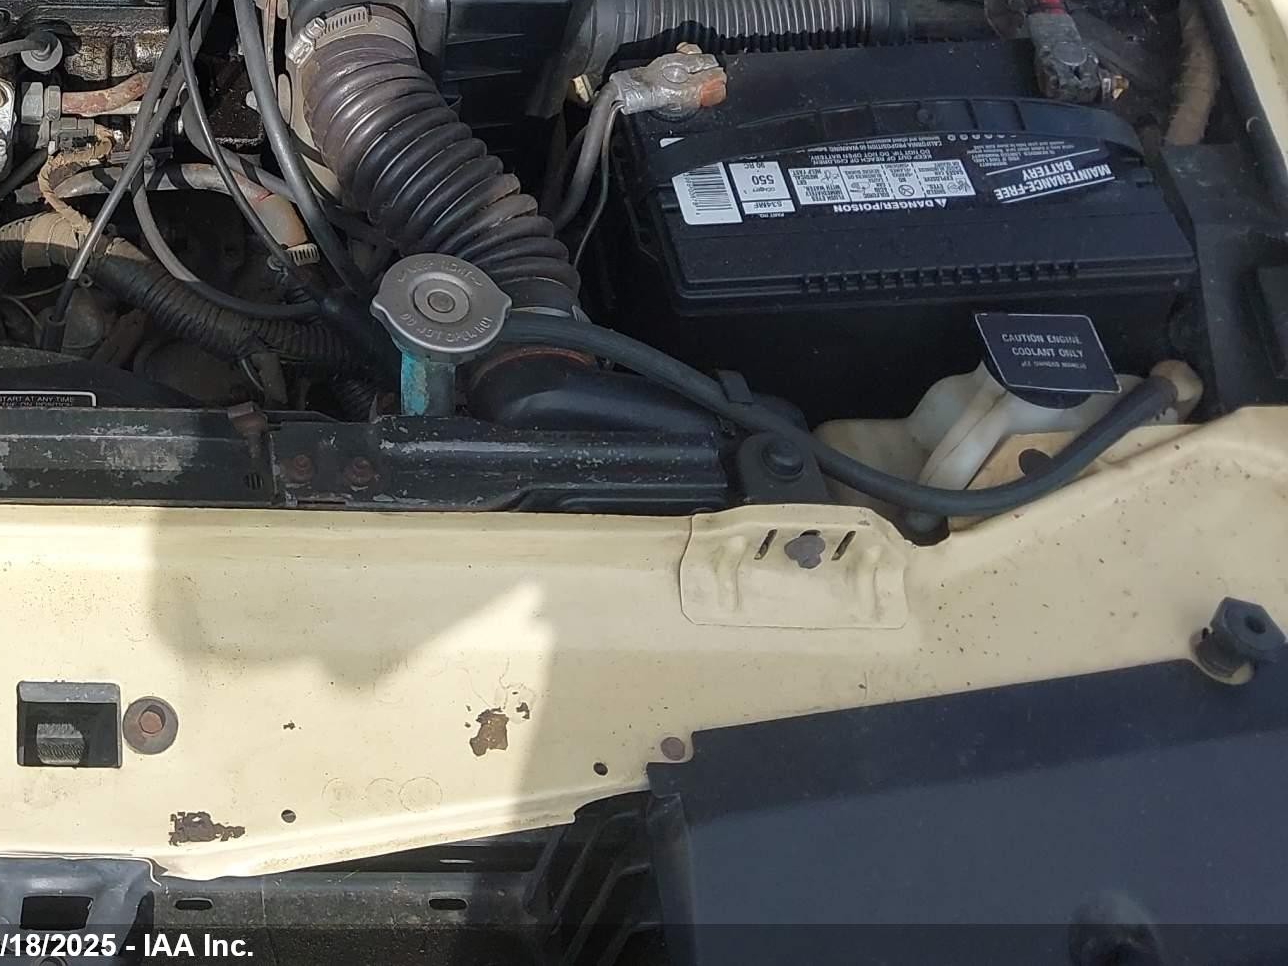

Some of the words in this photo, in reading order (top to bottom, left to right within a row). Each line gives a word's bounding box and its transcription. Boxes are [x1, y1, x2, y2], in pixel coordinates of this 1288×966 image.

[1022, 160, 1075, 181] BATTERY
[752, 175, 774, 185] 550
[993, 164, 1112, 200] MAINTENANCE-FREE
[833, 199, 934, 212] DANGER/POISON
[1001, 333, 1045, 343] CAUTION
[1046, 334, 1083, 345] ENGINE
[1012, 347, 1056, 357] COOLANT
[1058, 348, 1083, 358] ONLY
